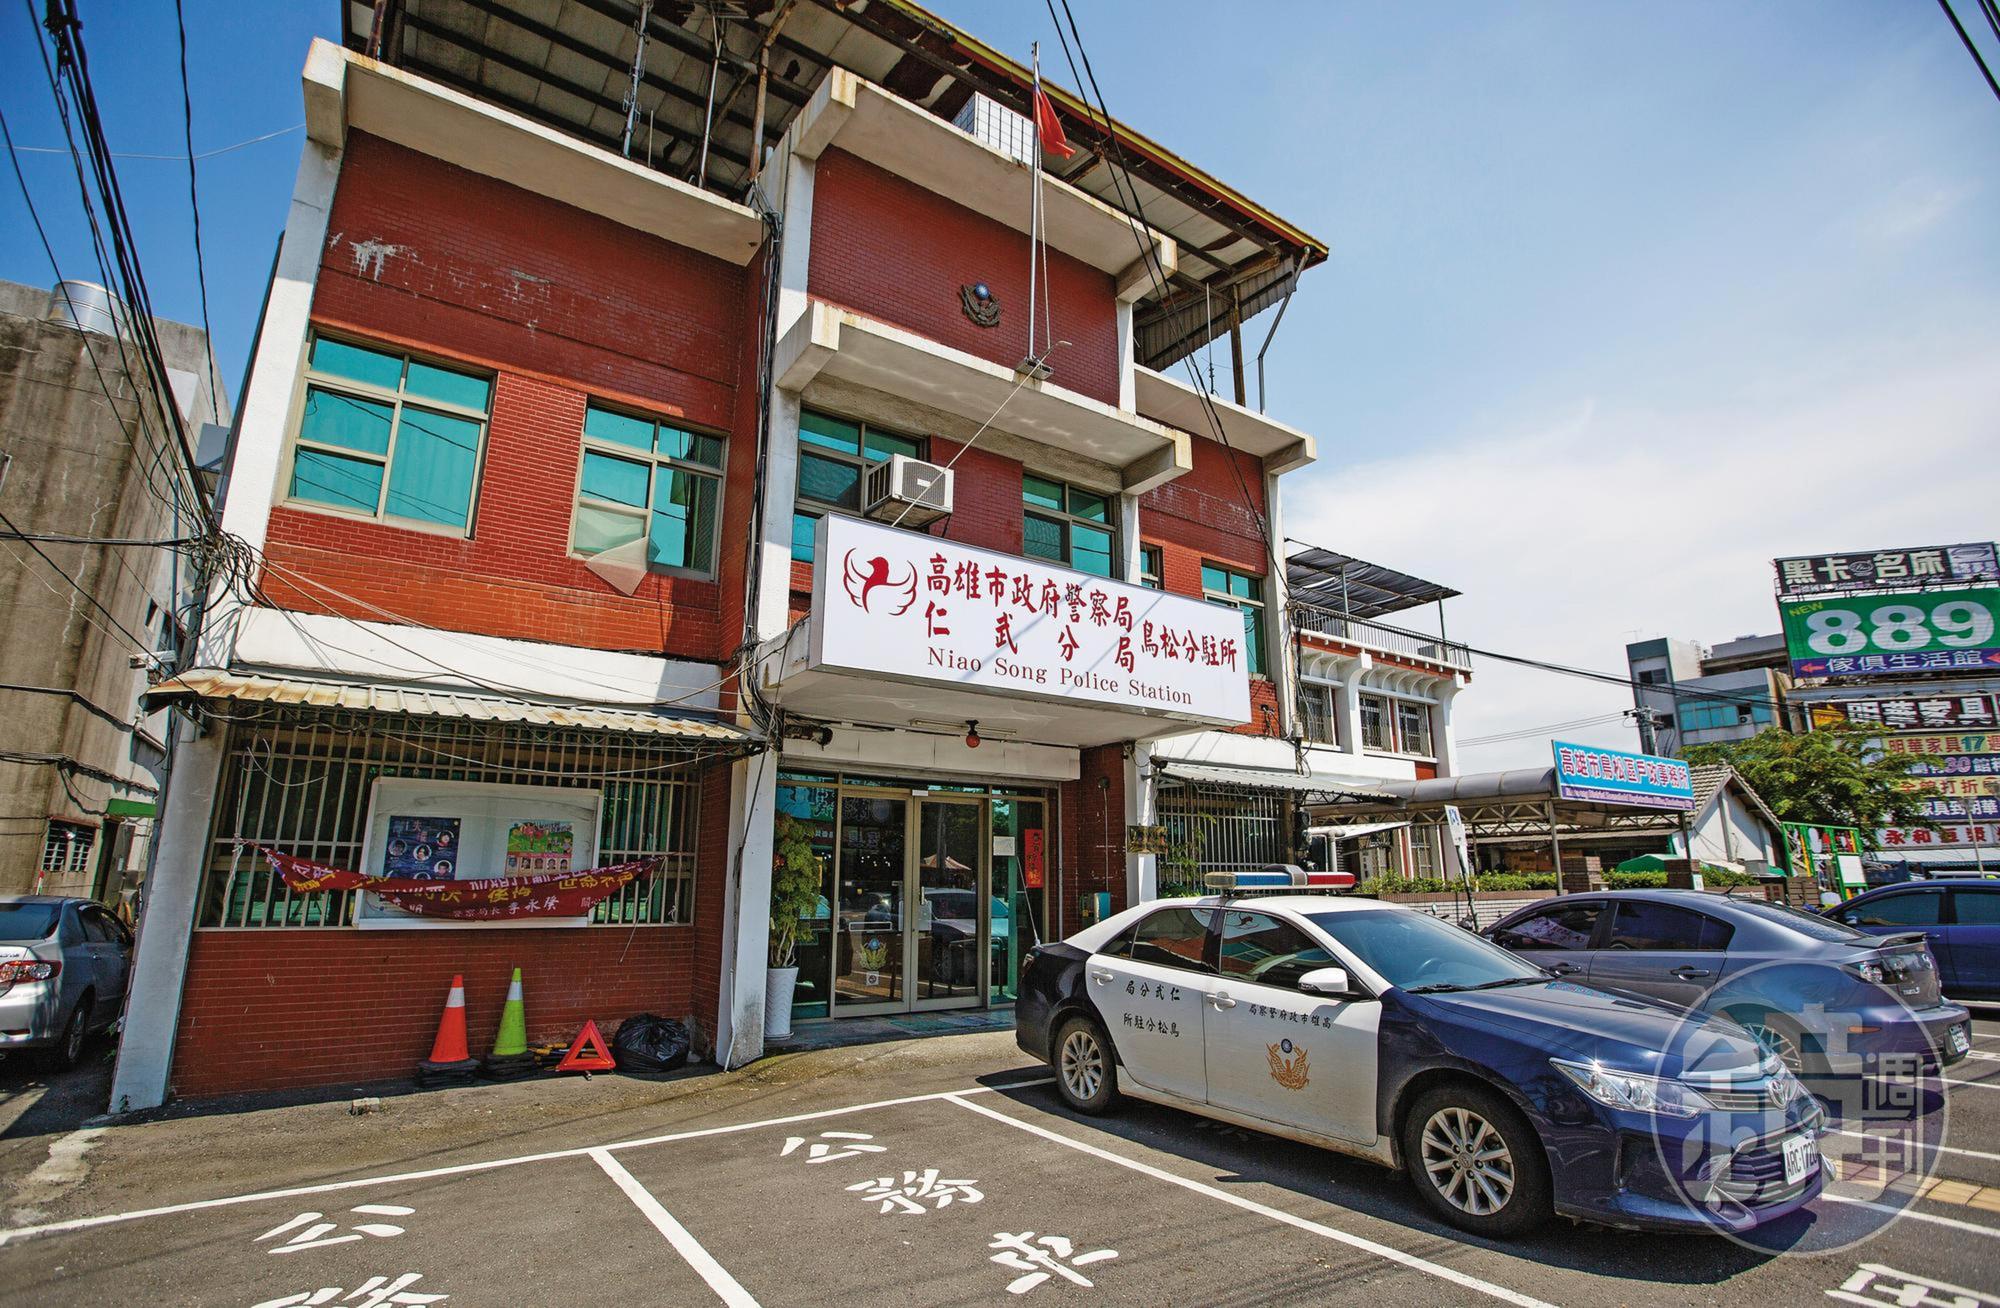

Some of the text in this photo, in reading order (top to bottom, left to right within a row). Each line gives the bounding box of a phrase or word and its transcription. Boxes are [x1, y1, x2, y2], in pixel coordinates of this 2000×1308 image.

[926, 552, 1133, 633] 高雄市政府警察局
[1789, 602, 1823, 615] NEW
[1141, 619, 1237, 672] 鳥松分駐所
[1806, 600, 1995, 655] 889
[927, 646, 1192, 705] Niao Song Police Station
[1825, 649, 1984, 673] 傢俱生活館
[1559, 747, 1690, 790] 高雄市鳥松區戶政事務所
